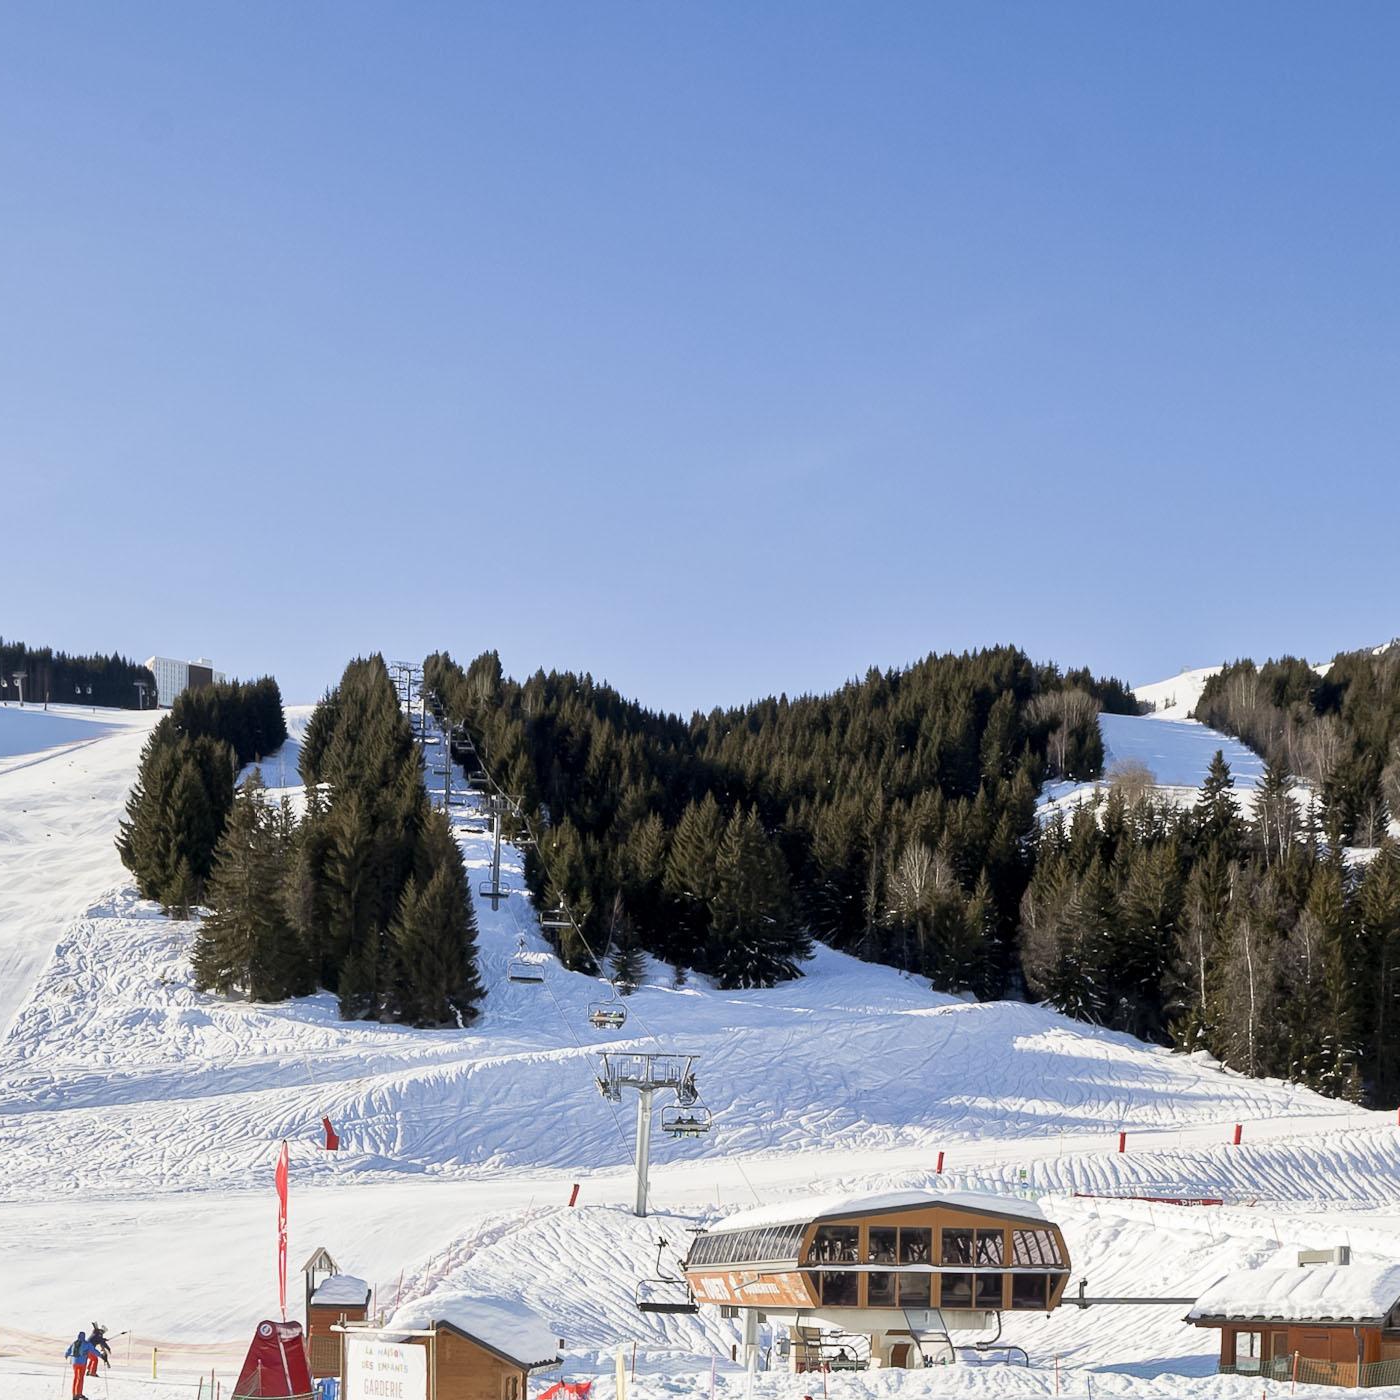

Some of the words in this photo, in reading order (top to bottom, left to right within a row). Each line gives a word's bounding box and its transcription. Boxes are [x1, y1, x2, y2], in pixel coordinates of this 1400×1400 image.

[377, 1346, 405, 1358] MAISON
[361, 1360, 374, 1370] DES
[378, 1362, 409, 1374] ENFANTS
[363, 1378, 404, 1399] GARDERIE
